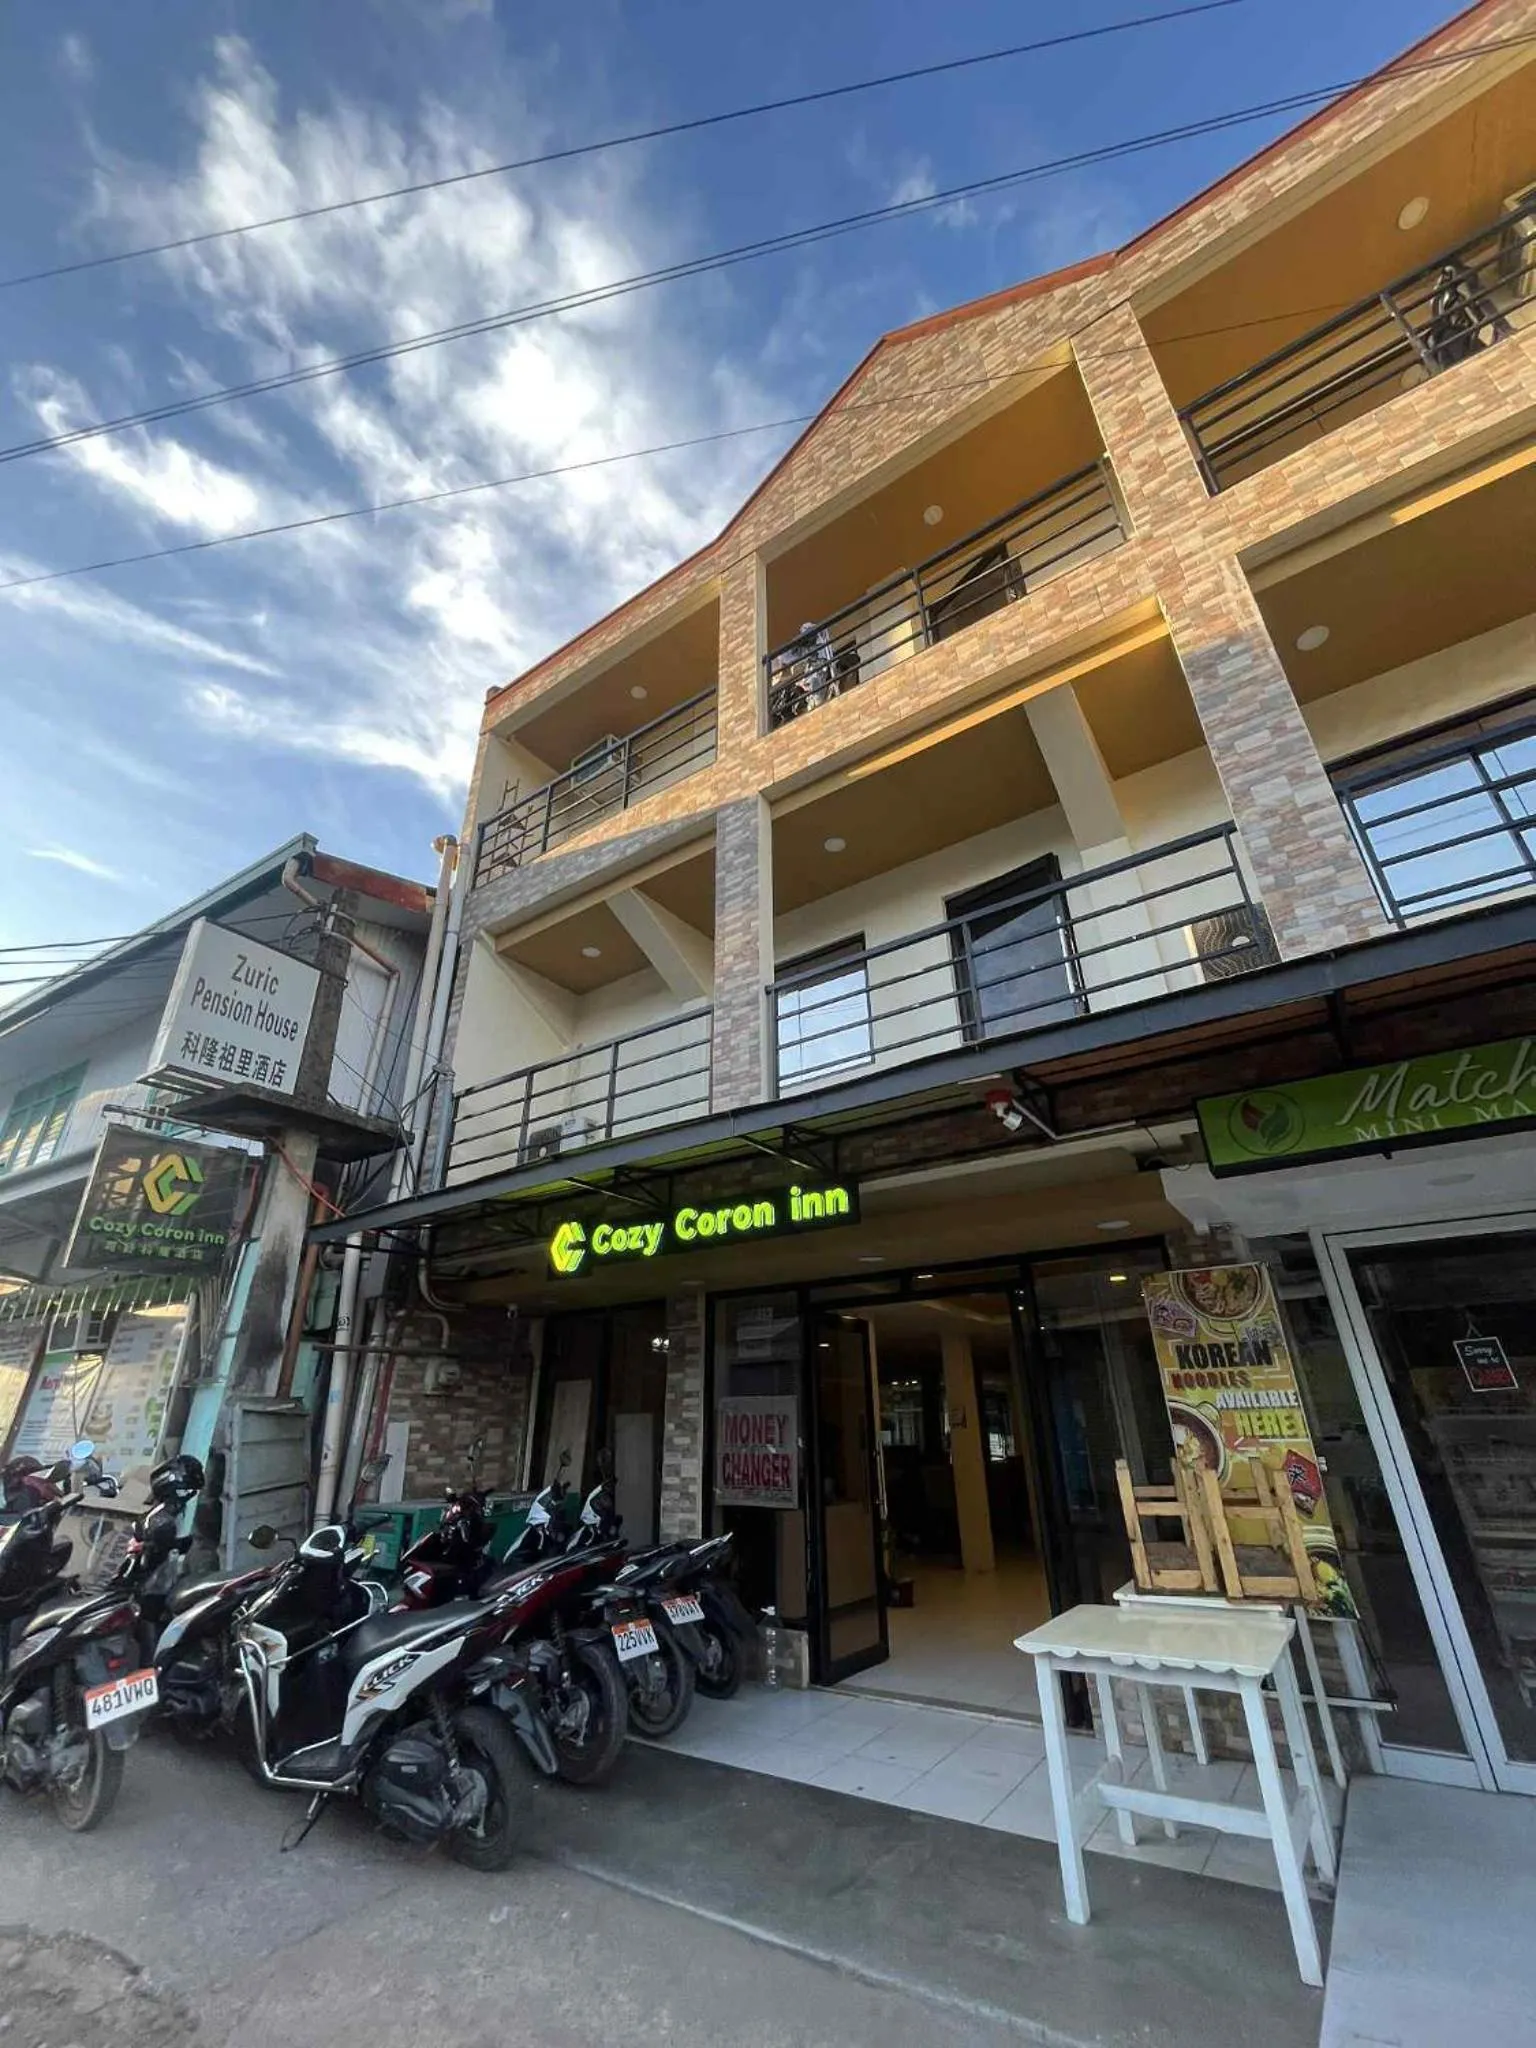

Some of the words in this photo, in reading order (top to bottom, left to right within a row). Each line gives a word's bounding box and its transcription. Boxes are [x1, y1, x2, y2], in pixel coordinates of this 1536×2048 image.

[231, 954, 280, 996] Zuric
[190, 977, 253, 1026] Pension
[254, 1000, 299, 1041] House
[180, 1030, 288, 1088] 科隆祖里酒店
[1353, 1112, 1444, 1143] MINI
[89, 1216, 137, 1238] Cozy
[140, 1222, 195, 1241] Coron
[591, 1222, 664, 1257] Cozy
[675, 1202, 775, 1240] Coron
[789, 1185, 850, 1222] inn
[1174, 1339, 1274, 1370] KOREAN
[1170, 1370, 1251, 1389] NOODLES
[1215, 1390, 1299, 1410] AVAILABLE
[723, 1413, 789, 1446] MONEY
[1234, 1407, 1301, 1437] HERE
[721, 1453, 793, 1488] CHANGER
[91, 1678, 154, 1717] 481VWQ
